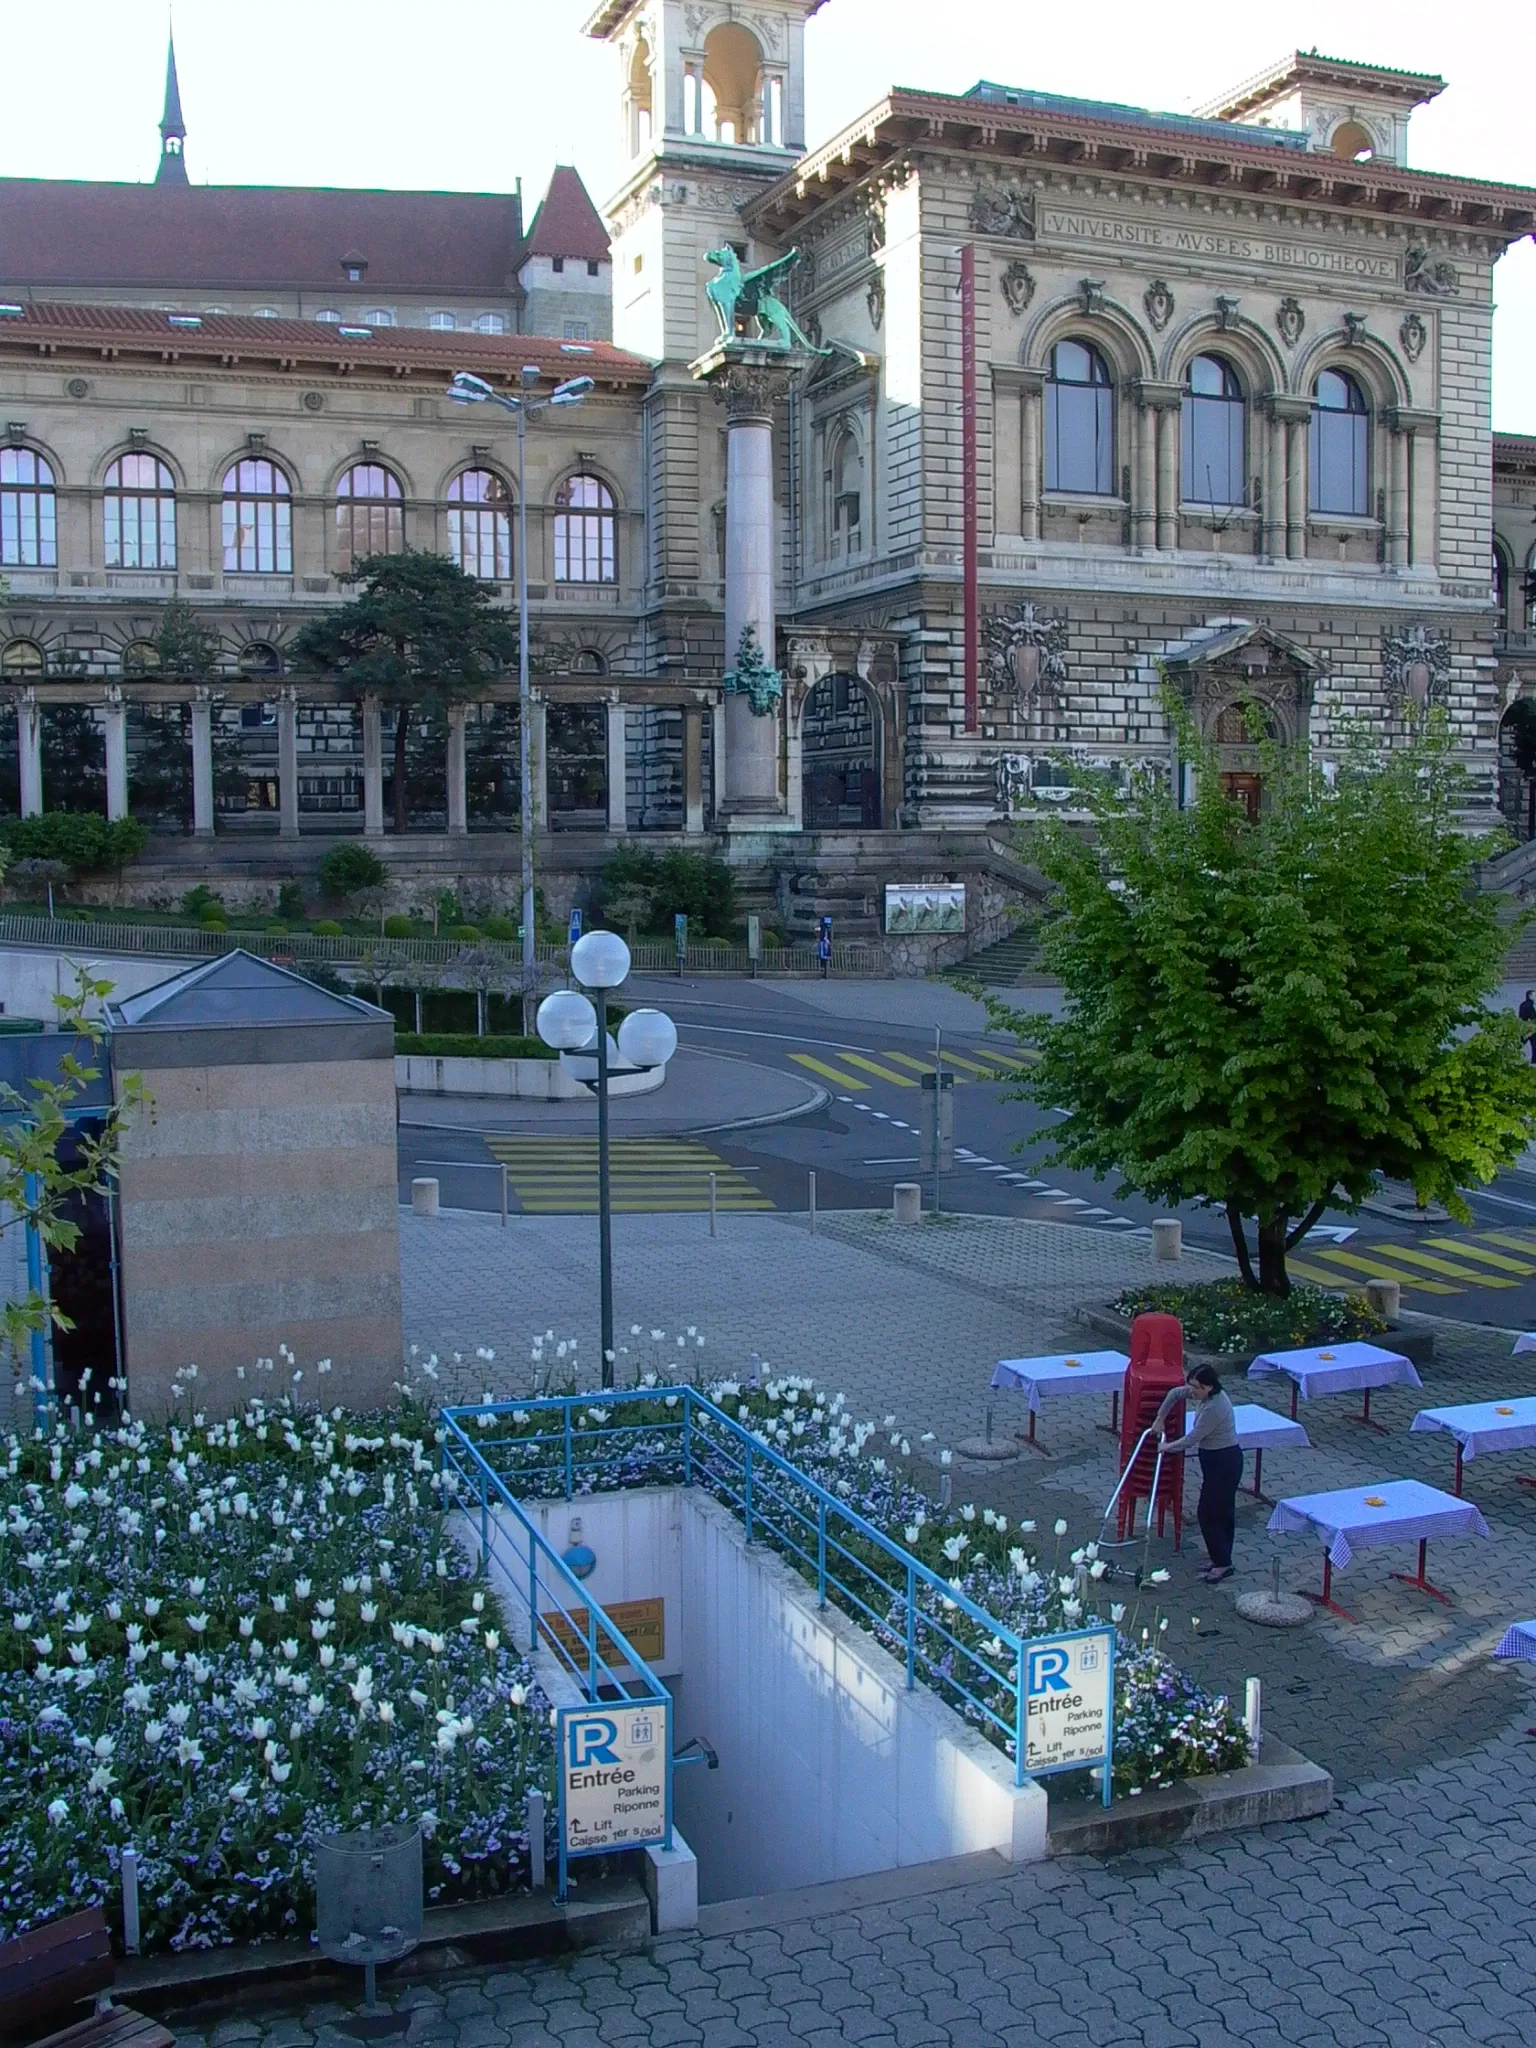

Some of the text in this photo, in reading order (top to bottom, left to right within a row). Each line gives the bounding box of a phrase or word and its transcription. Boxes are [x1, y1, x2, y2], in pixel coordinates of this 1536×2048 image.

[1028, 1693, 1083, 1717] Entrée
[1067, 1708, 1103, 1722] Parking
[1063, 1722, 1102, 1737] Riponne
[1046, 1741, 1062, 1753] Lift
[1025, 1755, 1058, 1768] Caisse
[1079, 1745, 1103, 1757] s/sol
[569, 1767, 636, 1790] Entrée
[617, 1784, 660, 1799] Parking
[613, 1800, 660, 1815] Riponne
[594, 1820, 612, 1831] Lift
[569, 1834, 607, 1847] Caisse
[633, 1825, 661, 1838] s/sol
